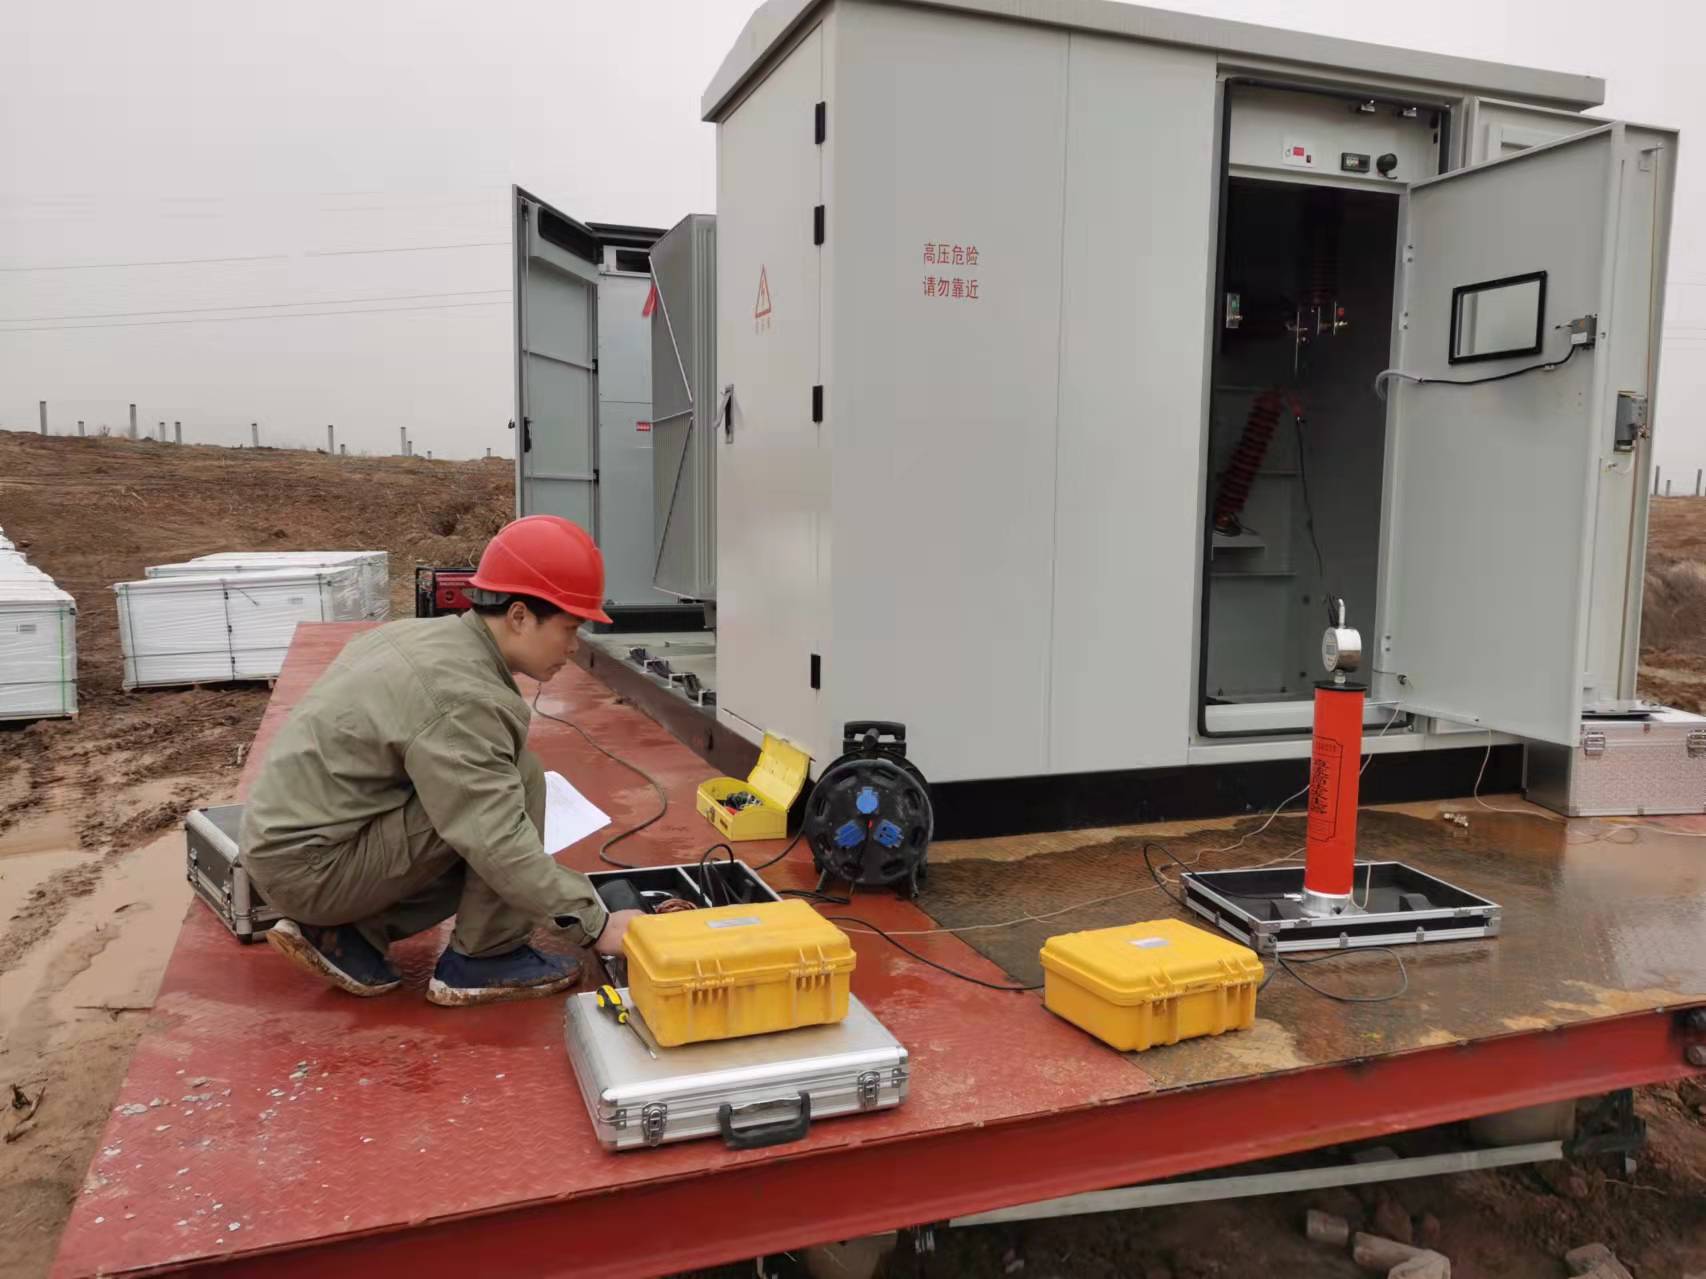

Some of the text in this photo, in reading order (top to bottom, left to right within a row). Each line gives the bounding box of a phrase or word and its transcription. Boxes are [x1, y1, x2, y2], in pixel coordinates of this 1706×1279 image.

[924, 242, 980, 266] 高压危险
[923, 275, 979, 299] 请勿靠近
